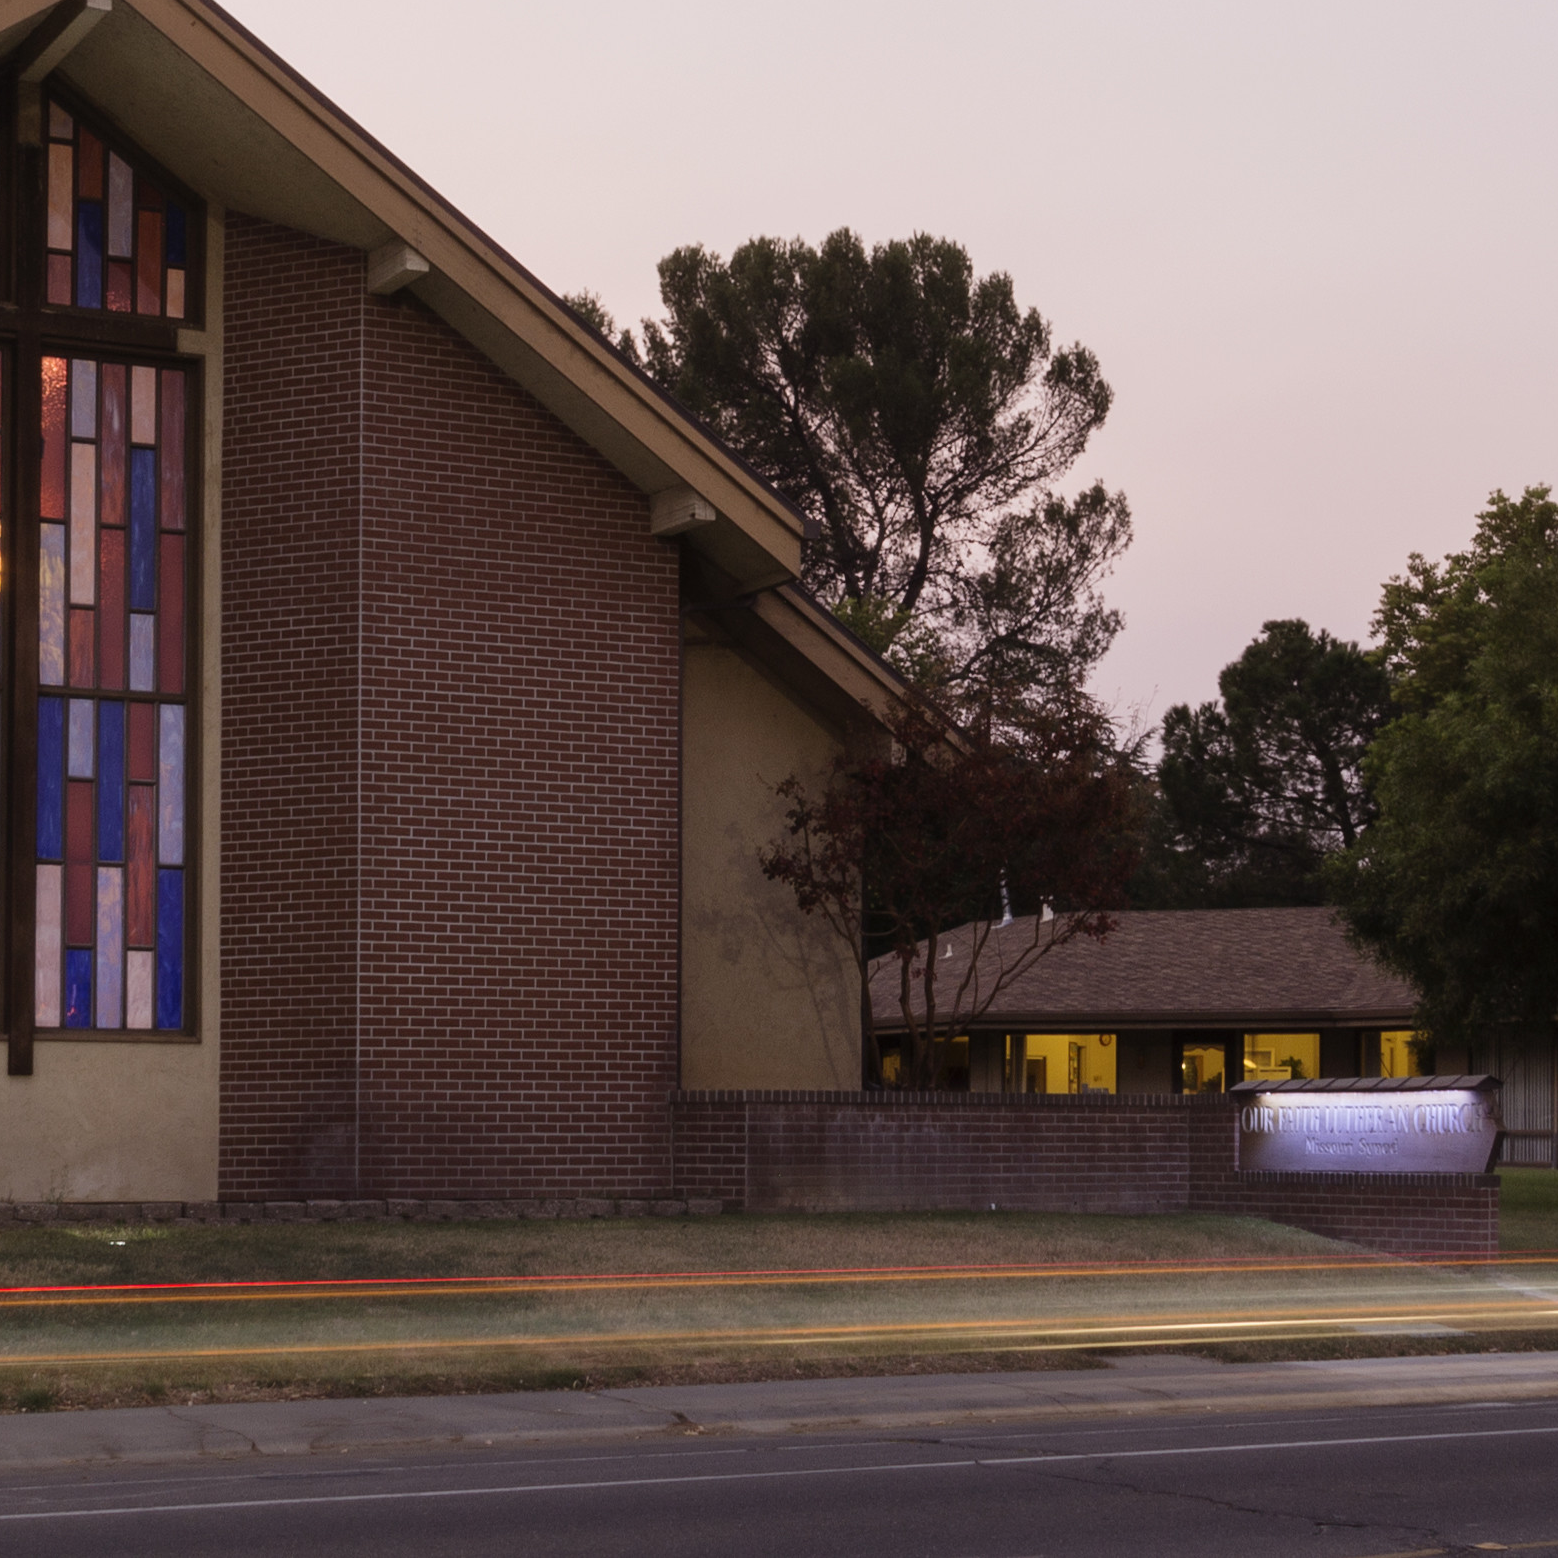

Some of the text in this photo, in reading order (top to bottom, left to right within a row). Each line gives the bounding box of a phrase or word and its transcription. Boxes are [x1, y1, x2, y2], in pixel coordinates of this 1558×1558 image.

[1241, 1103, 1483, 1134] OUR FAITH LUTHERAN CHURCH
[1305, 1136, 1398, 1158] Missouri Synod
